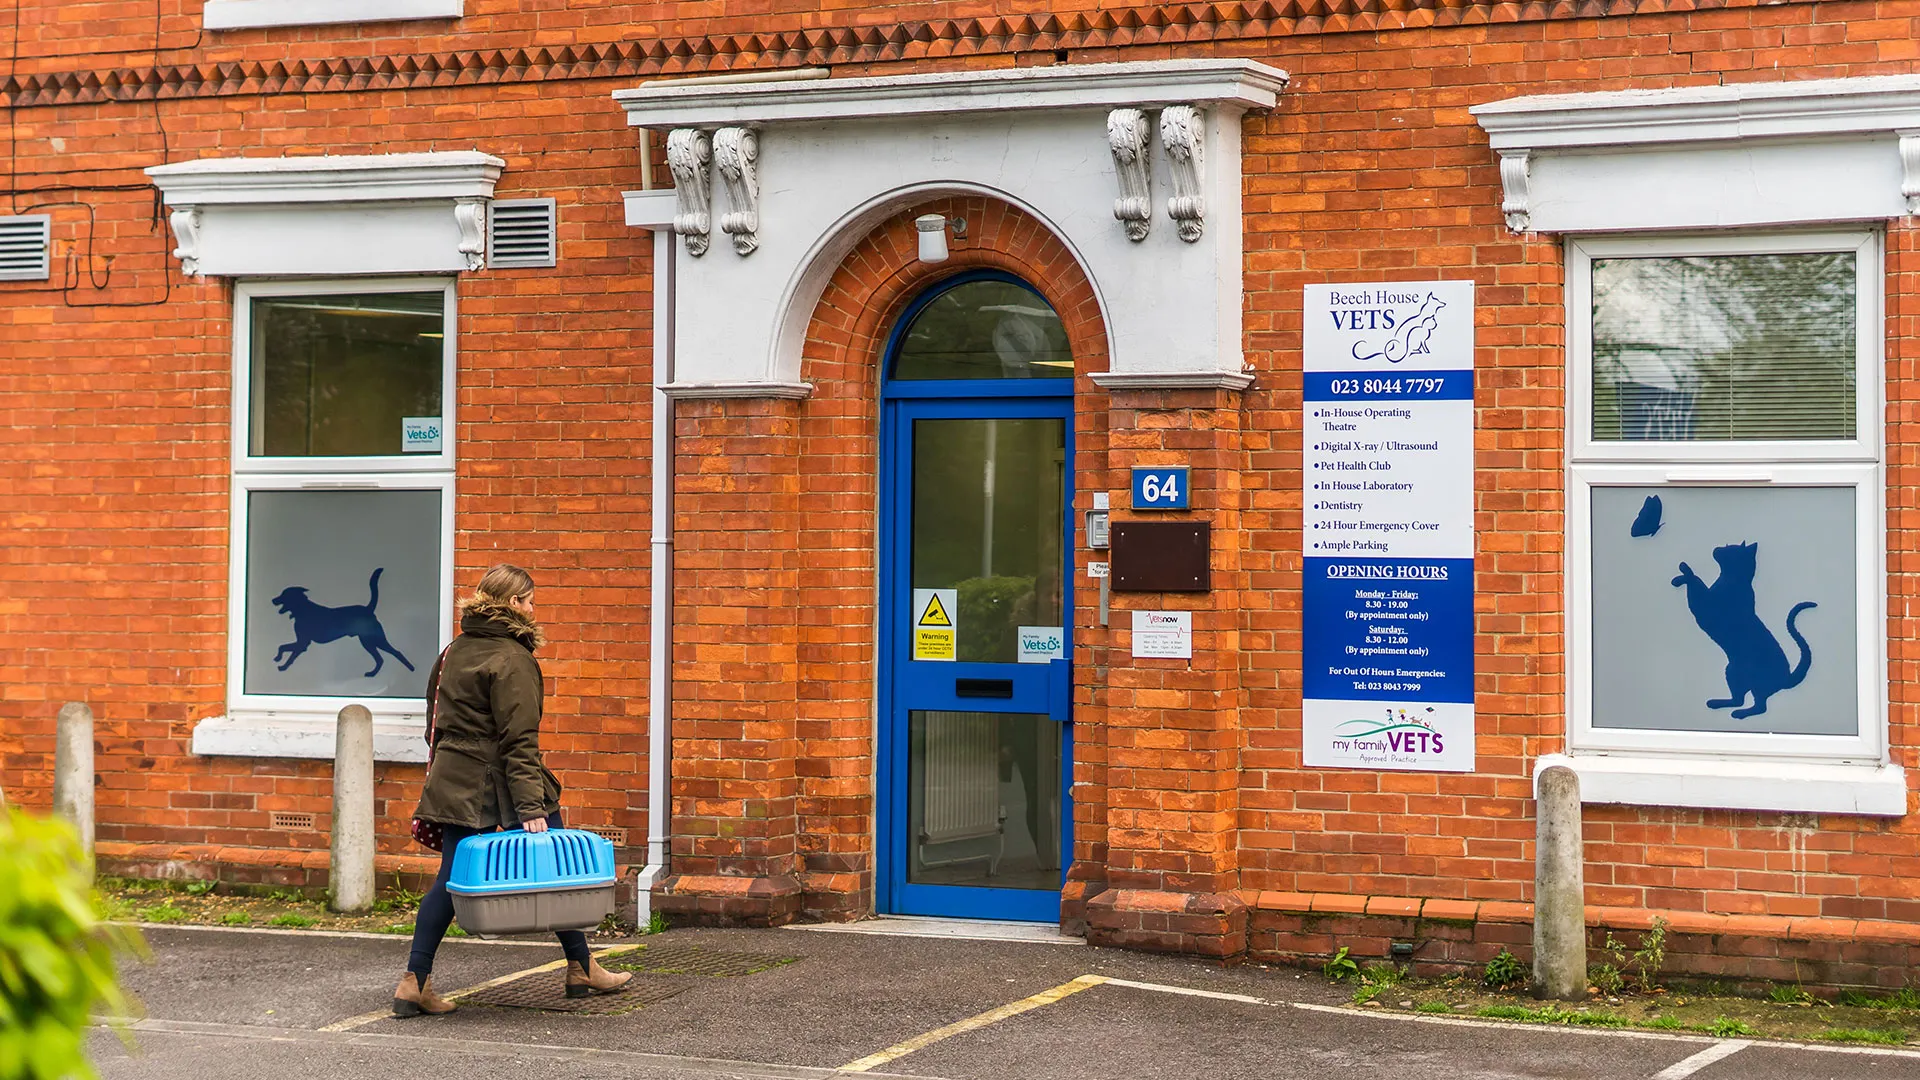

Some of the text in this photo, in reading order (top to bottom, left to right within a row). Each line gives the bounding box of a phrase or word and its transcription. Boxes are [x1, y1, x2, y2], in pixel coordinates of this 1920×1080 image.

[1330, 290, 1419, 305] Beech House
[1330, 309, 1395, 330] VETS
[1331, 378, 1444, 394] 023 8044 7797
[1321, 408, 1411, 419] In-House Operating
[1323, 422, 1356, 431] Theatre
[407, 430, 427, 439] Vets
[1321, 442, 1351, 453] Digital
[1354, 442, 1378, 453] X-ray
[1386, 441, 1438, 451] Ultrasound
[1321, 461, 1391, 470] Pet Health Club
[1142, 475, 1178, 502] 64
[1321, 481, 1413, 492] In House Laboratory
[1321, 501, 1363, 512] Dentistry
[1320, 521, 1439, 532] 24 Hour Emergency Cover
[1321, 540, 1388, 552] Ample Parking
[1327, 565, 1448, 578] OPENING HOURS
[1355, 590, 1385, 599] Monday
[1392, 590, 1418, 600] Friday:
[1345, 610, 1428, 621] (By appointment only)
[1369, 625, 1405, 634] Saturday:
[1023, 640, 1046, 650] Vets
[1345, 645, 1428, 657] (By appointment only)
[1329, 667, 1446, 679] For Out Of Hours Emergencies:
[1383, 683, 1401, 691] 8043
[1332, 732, 1444, 754] my family VETS
[1359, 754, 1417, 763] Approved Practice
